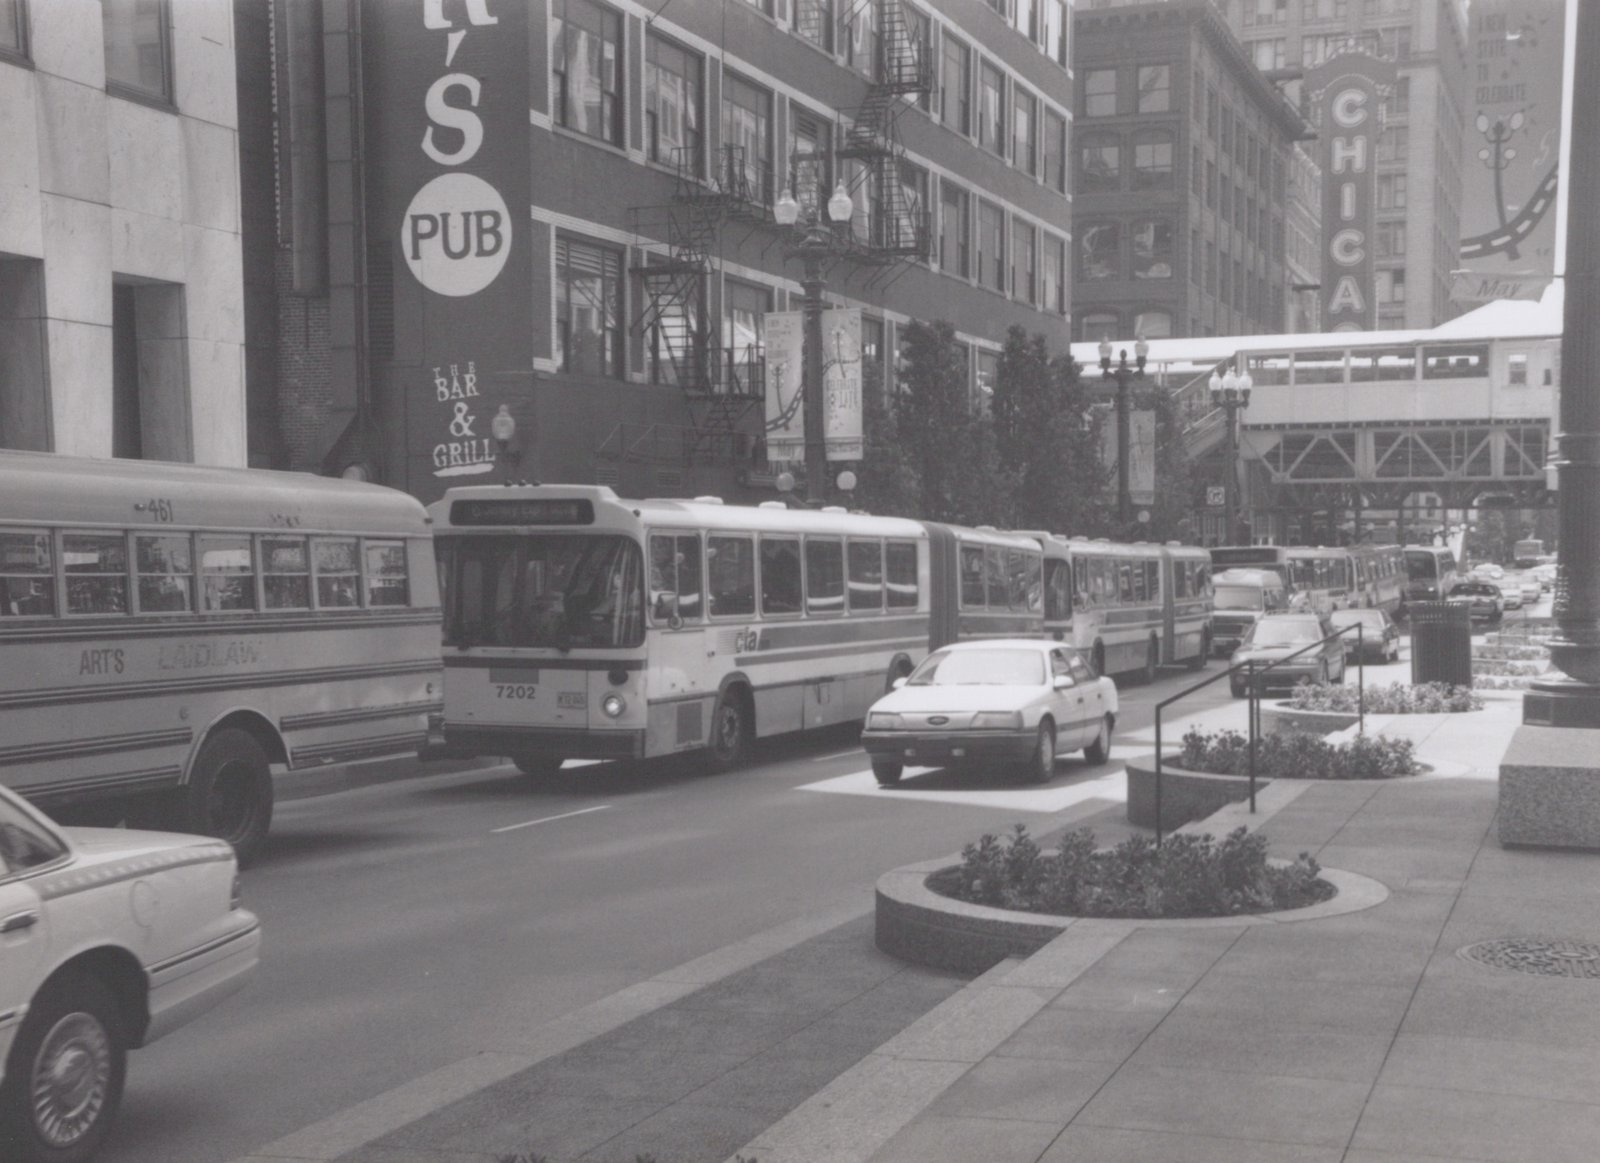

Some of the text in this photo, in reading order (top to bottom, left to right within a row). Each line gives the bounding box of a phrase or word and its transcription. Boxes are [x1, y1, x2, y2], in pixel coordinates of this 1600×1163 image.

[1477, 39, 1507, 59] STATE
[1476, 83, 1527, 105] CELEBRATE
[1327, 88, 1368, 332] CHICA
[409, 209, 503, 261] PUB
[1476, 279, 1523, 299] May
[432, 361, 477, 380] THE
[434, 373, 481, 402] BAR
[449, 401, 477, 437] &
[148, 498, 175, 523] 461
[734, 626, 757, 653] cta
[79, 641, 262, 676] ART'S LAIDLAW
[496, 686, 536, 700] 7202
